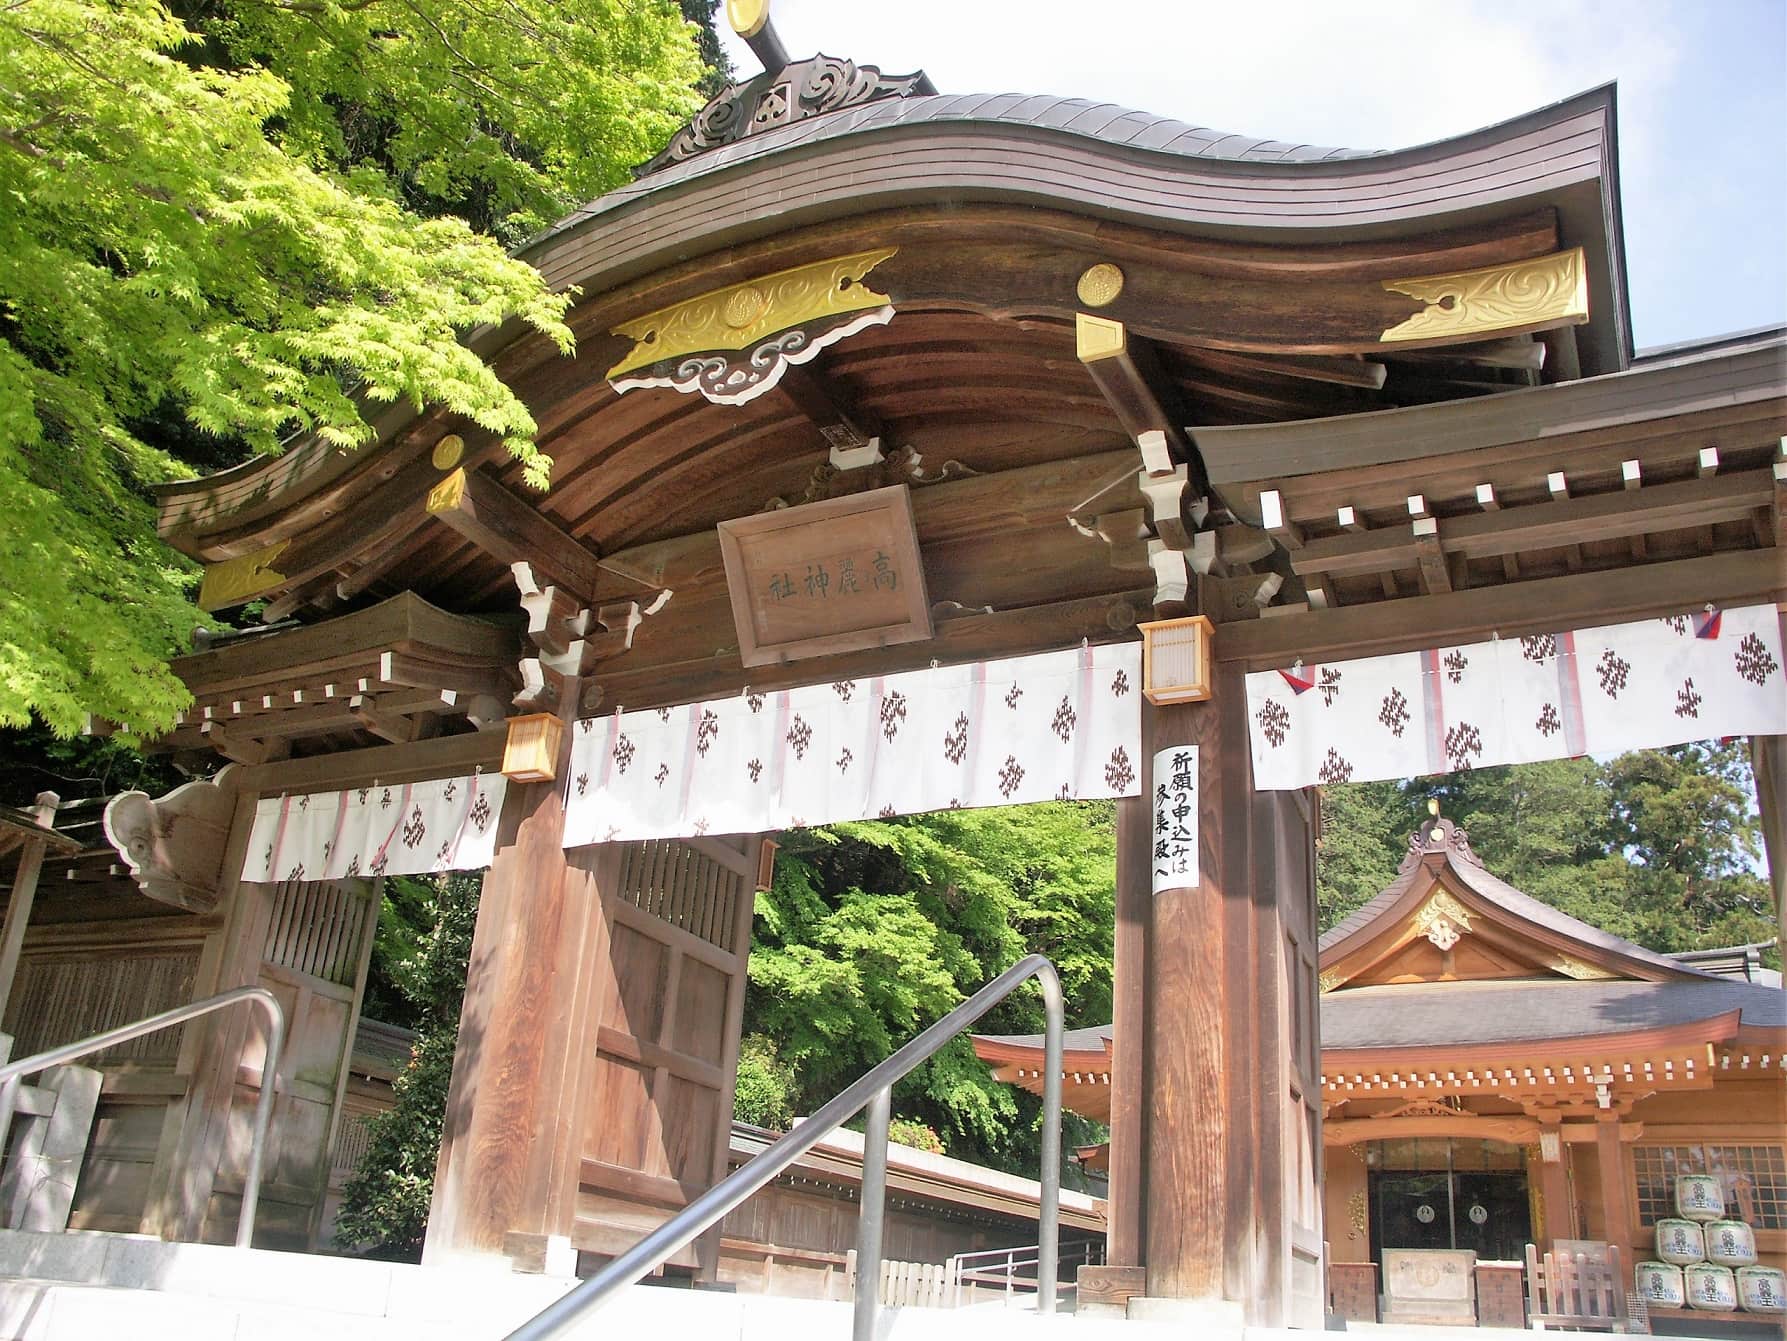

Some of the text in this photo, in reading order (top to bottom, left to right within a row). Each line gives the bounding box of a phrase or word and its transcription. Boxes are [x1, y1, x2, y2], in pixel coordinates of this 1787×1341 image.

[1169, 751, 1194, 874] 祈願の申込みは
